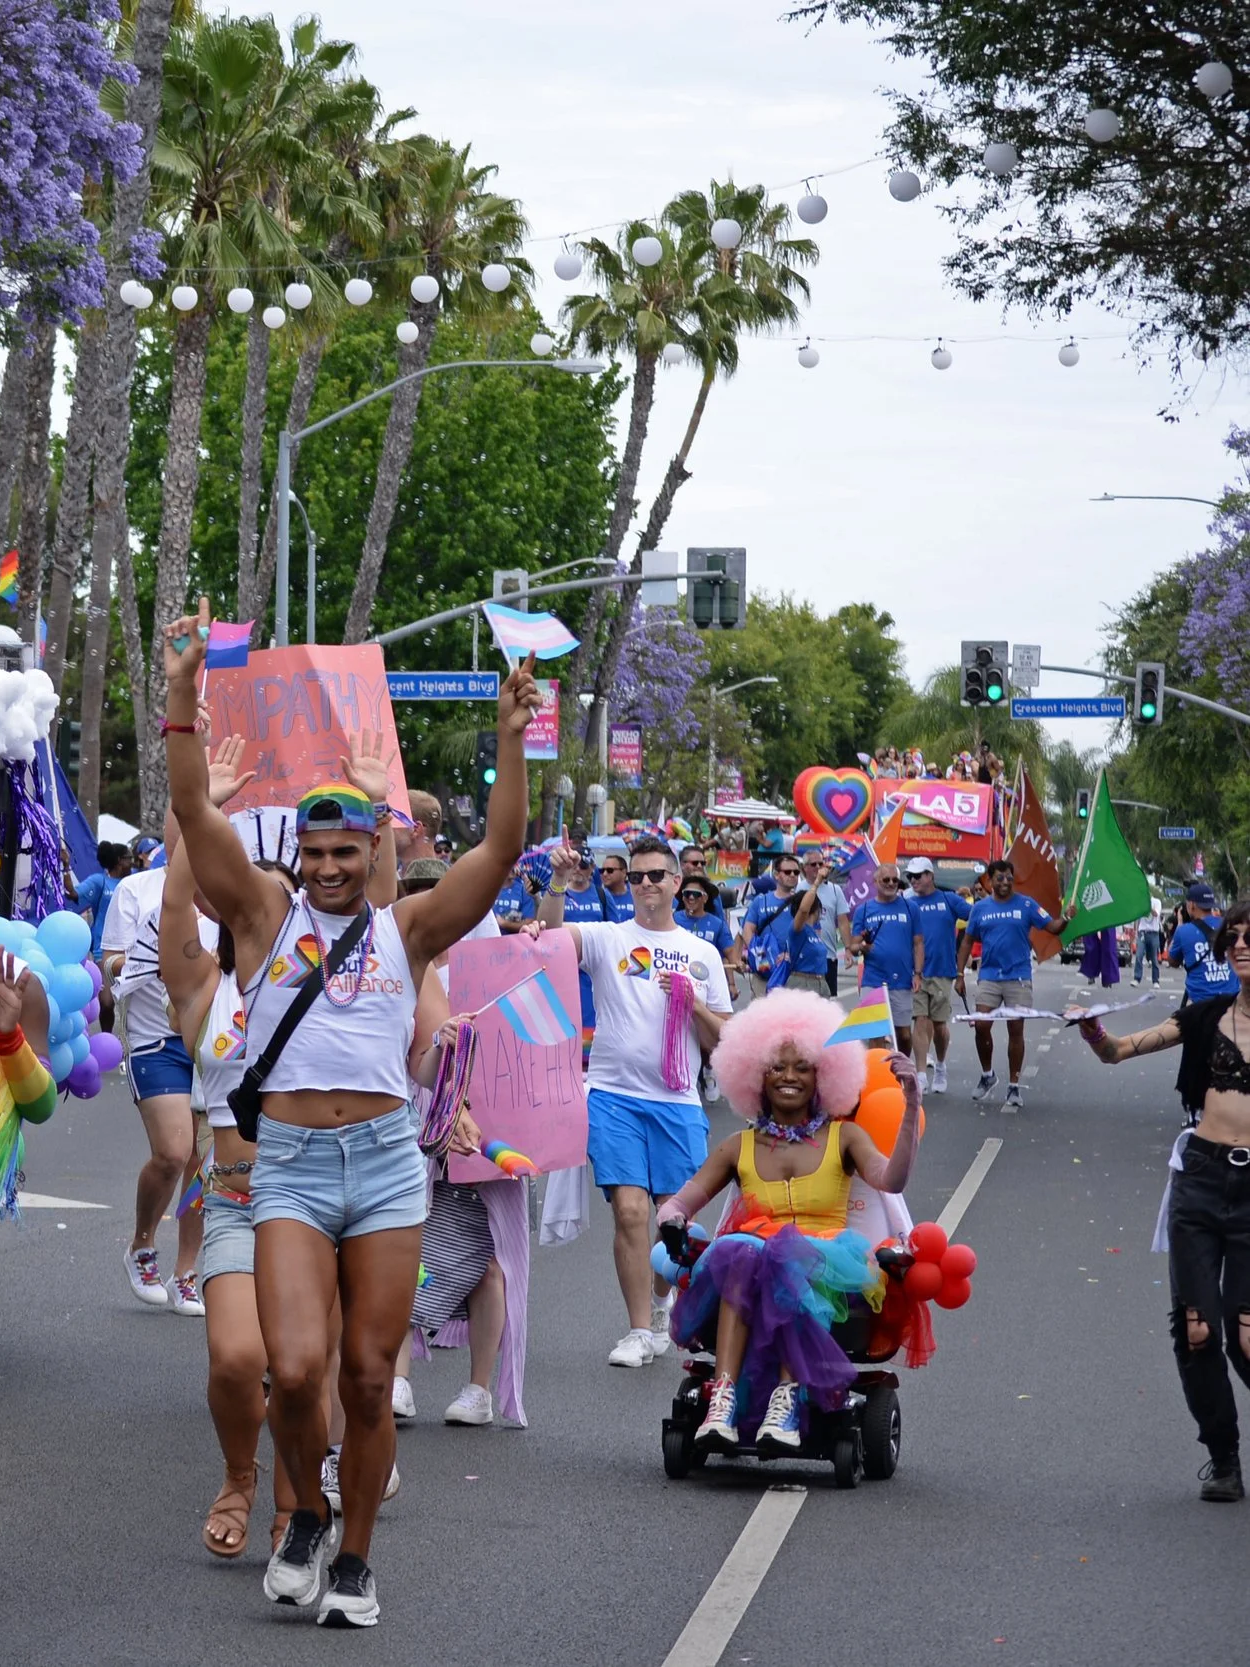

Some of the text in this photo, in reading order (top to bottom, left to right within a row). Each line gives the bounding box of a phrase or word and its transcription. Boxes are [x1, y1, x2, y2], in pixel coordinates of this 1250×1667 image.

[419, 680, 464, 695] Heights
[469, 680, 495, 691] Blvd
[1014, 703, 1122, 714] Crescent Heights Blvd
[526, 733, 546, 741] JUNE
[957, 796, 976, 814] 5
[866, 915, 897, 923] UNITED
[981, 912, 1012, 921] UNITED
[654, 948, 689, 964] Build
[653, 958, 679, 972] Out
[1205, 971, 1231, 982] WAY
[329, 974, 404, 994] Alliance
